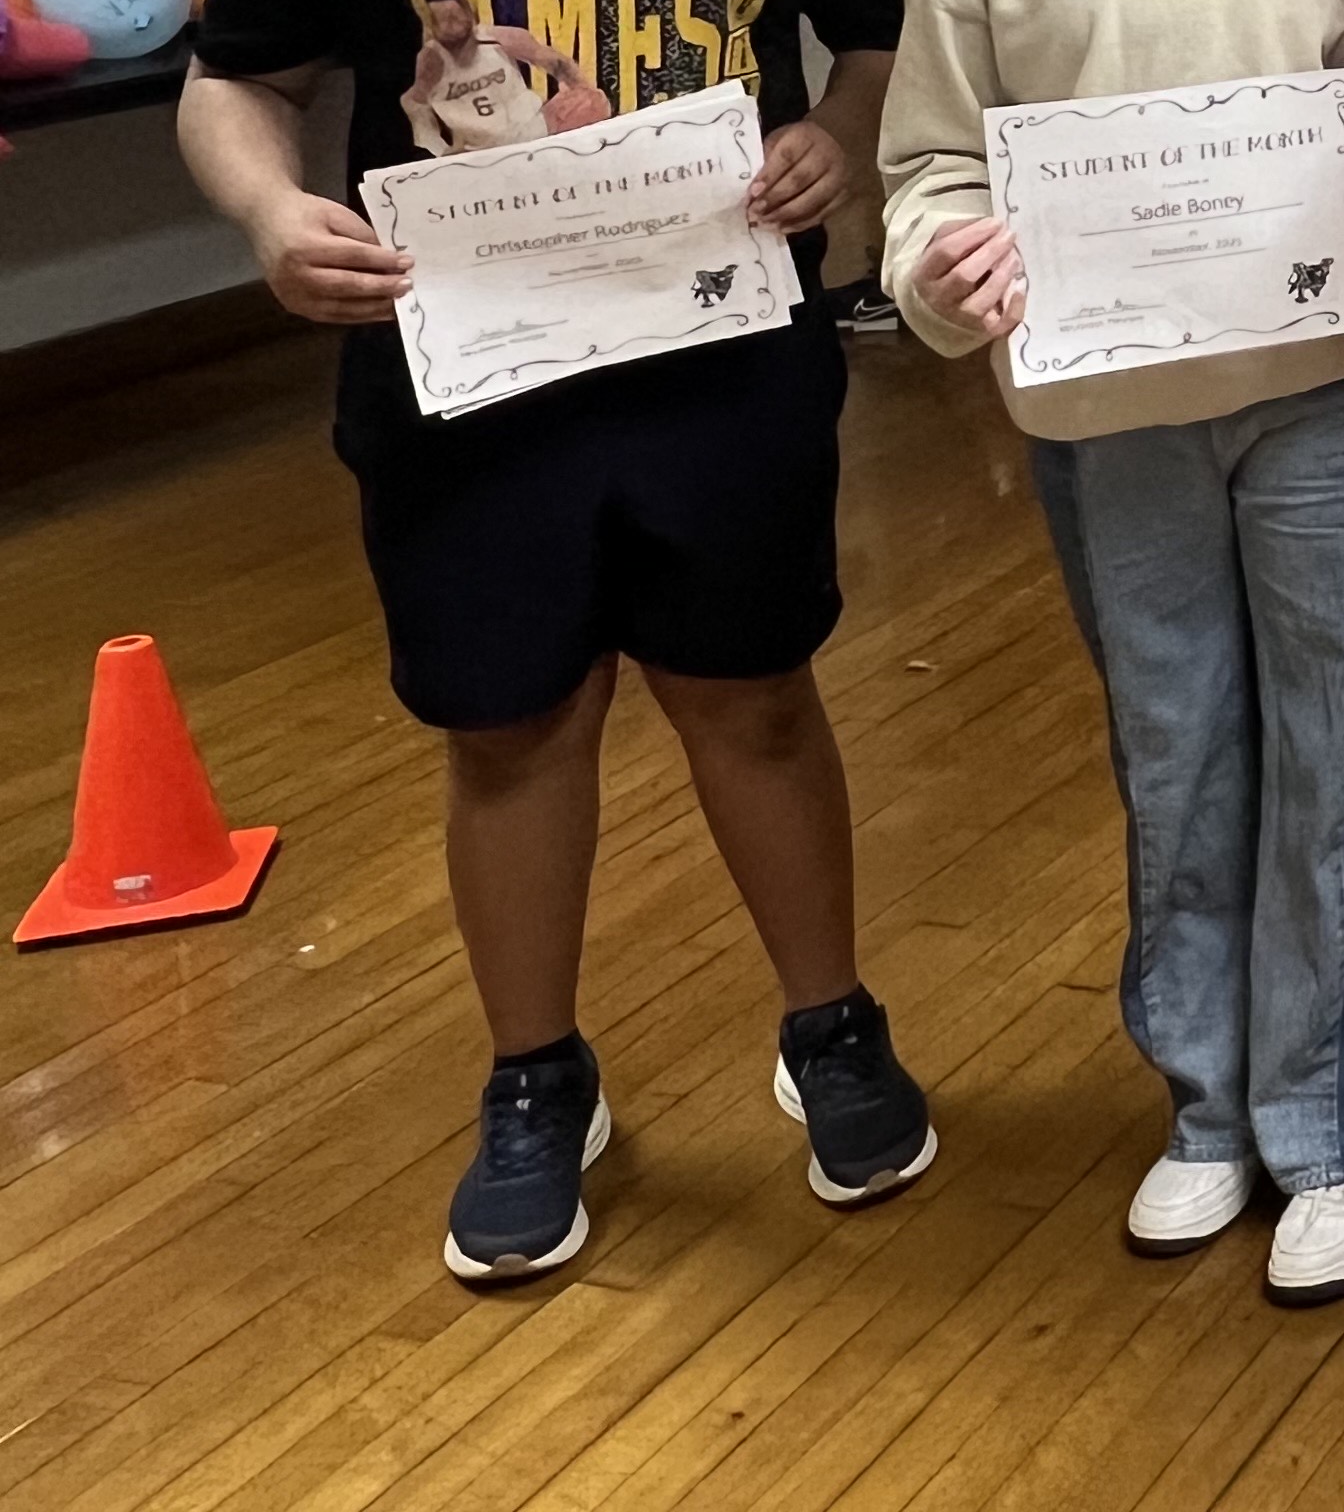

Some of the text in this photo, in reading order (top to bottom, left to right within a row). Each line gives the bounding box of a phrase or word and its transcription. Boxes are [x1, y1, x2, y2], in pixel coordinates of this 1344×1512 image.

[1131, 199, 1183, 223] Sadie
[474, 211, 692, 260] Christopher Rodriguez
